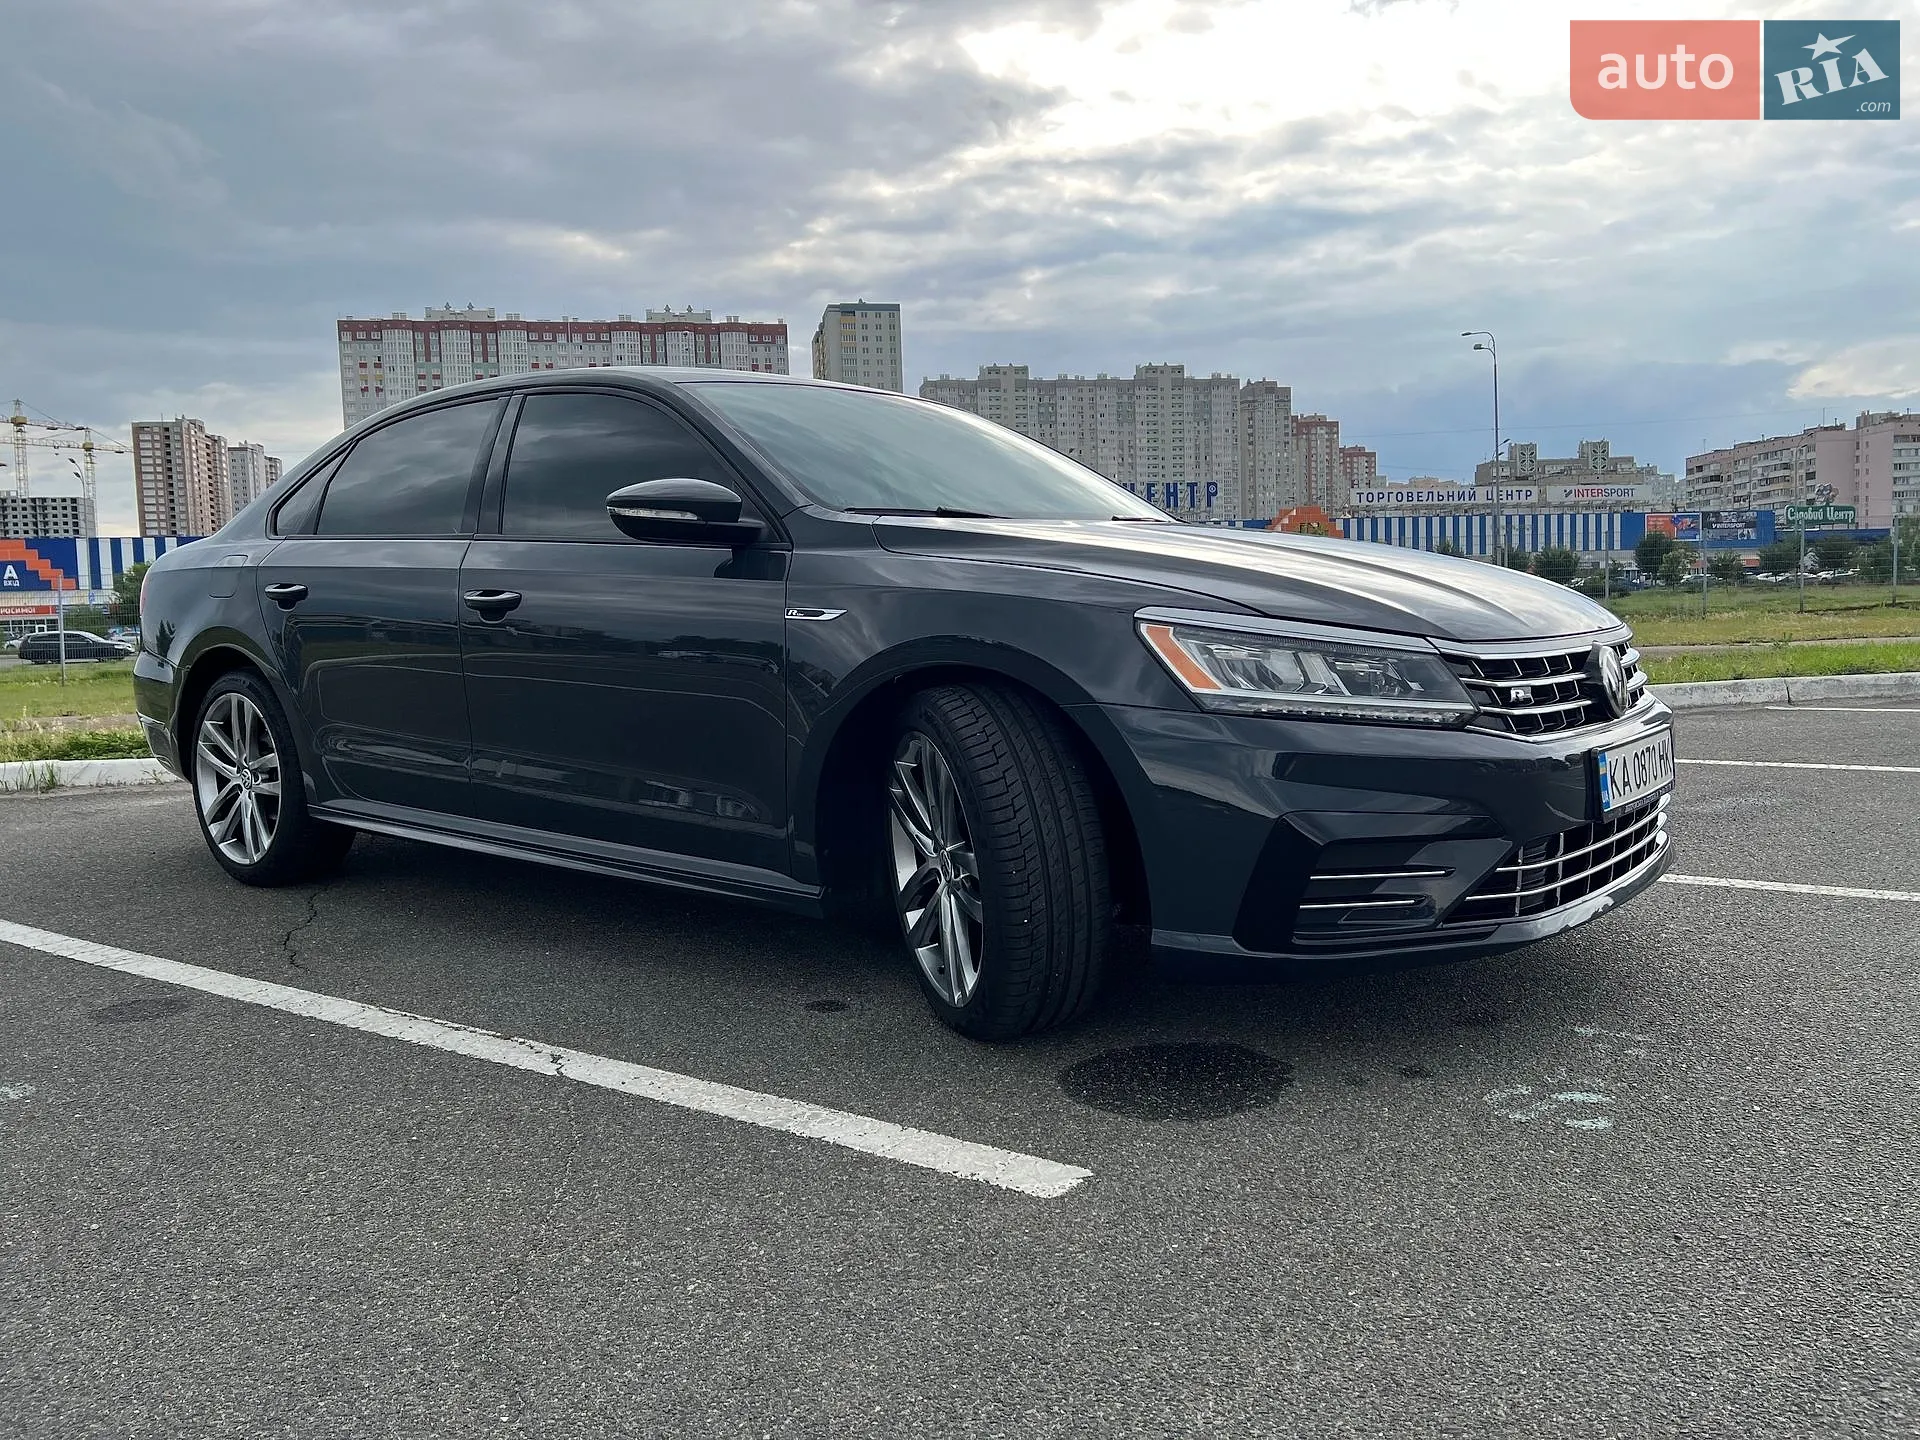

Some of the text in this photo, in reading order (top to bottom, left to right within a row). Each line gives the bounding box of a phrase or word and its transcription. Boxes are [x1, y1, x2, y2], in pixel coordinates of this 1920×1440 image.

[1356, 487, 1476, 504] ТОРГОВЕЛЬНИЙ
[1574, 488, 1635, 498] INTERSPORT
[1609, 755, 1632, 799] KA
[1633, 744, 1658, 790] 0870
